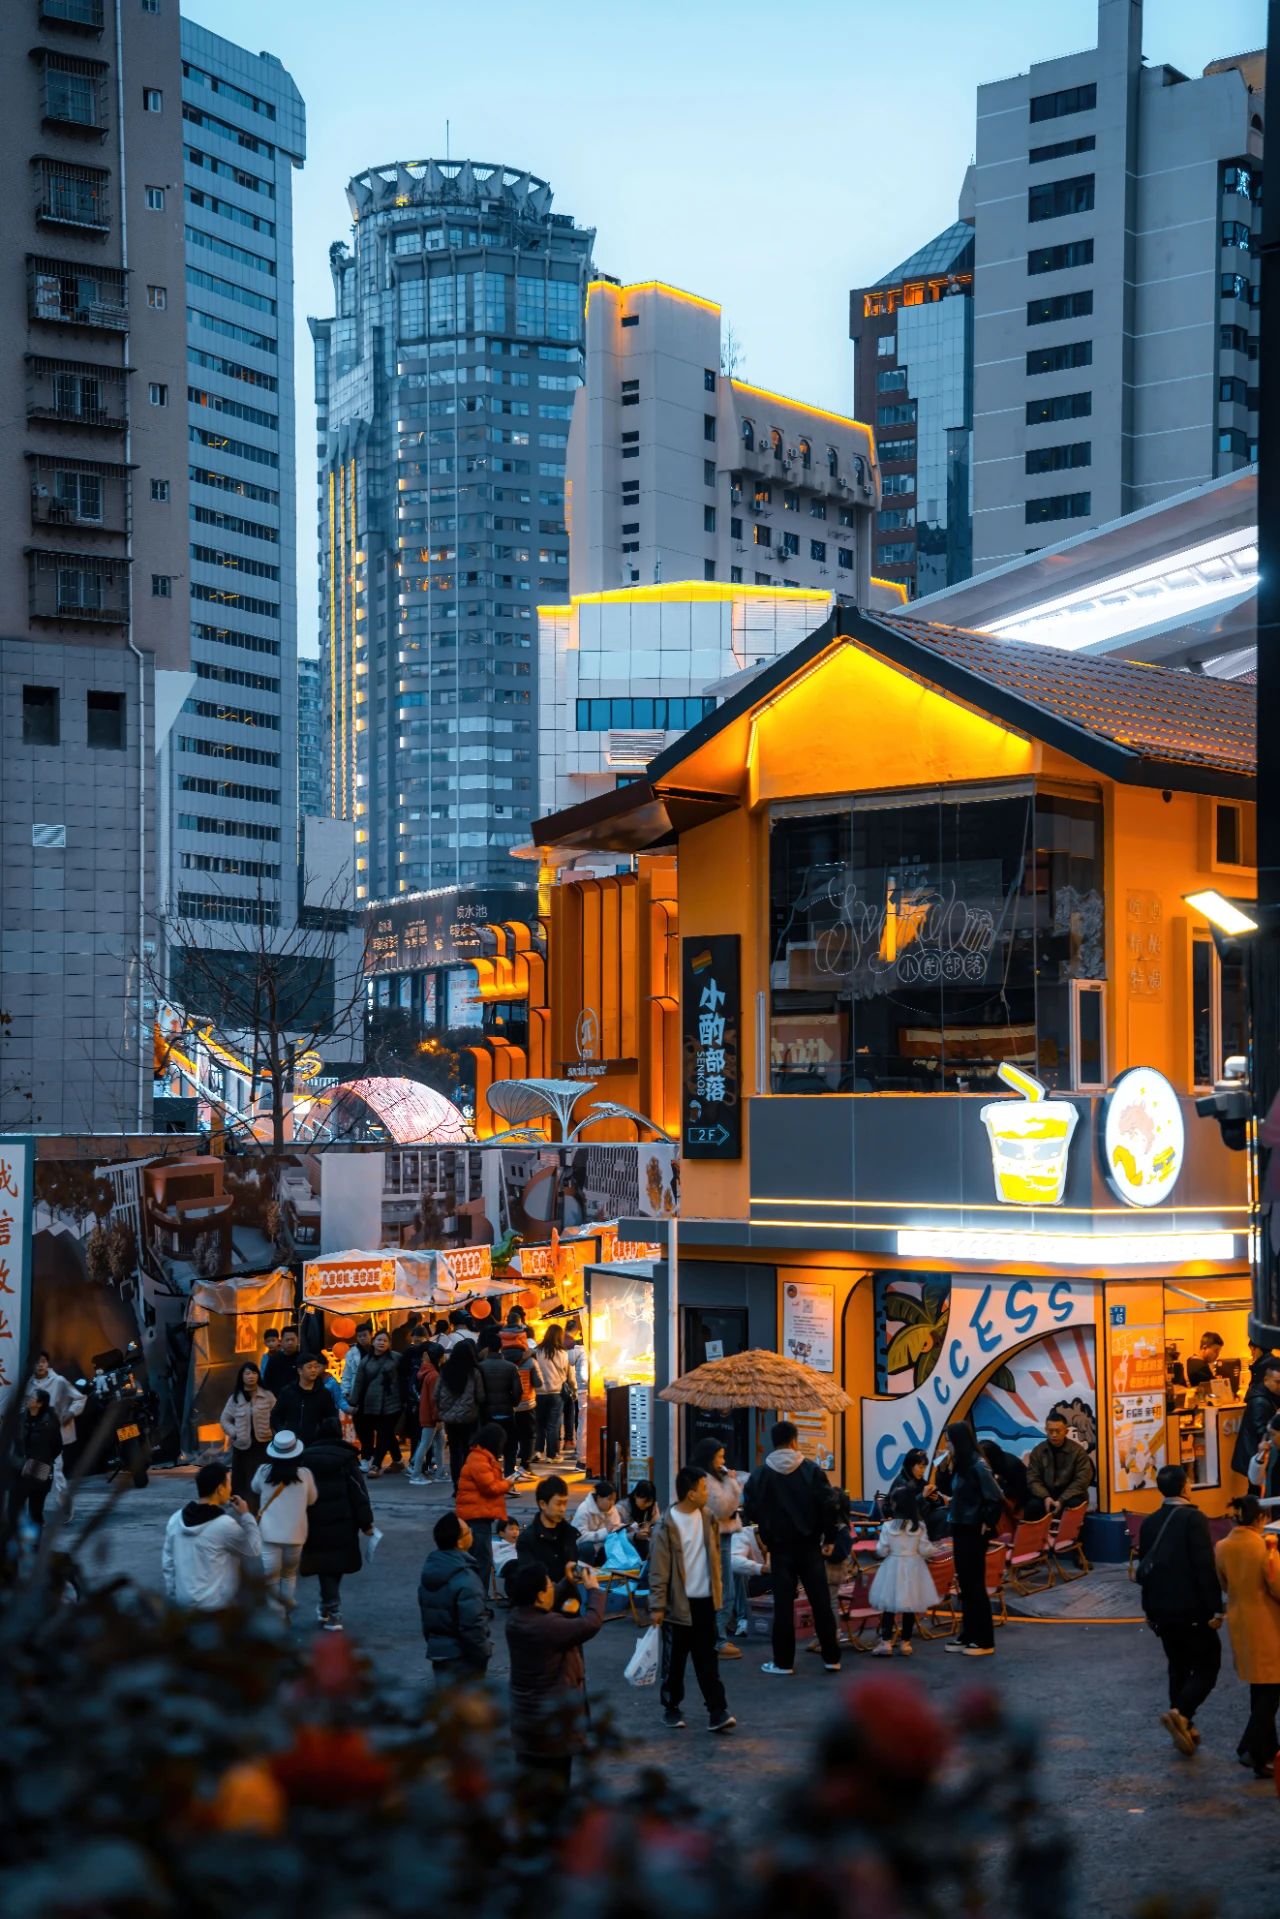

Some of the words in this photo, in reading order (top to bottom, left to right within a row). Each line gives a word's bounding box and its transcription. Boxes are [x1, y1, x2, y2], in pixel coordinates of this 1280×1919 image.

[699, 977, 726, 1102] 小酌部落
[698, 1129, 716, 1141] 2F
